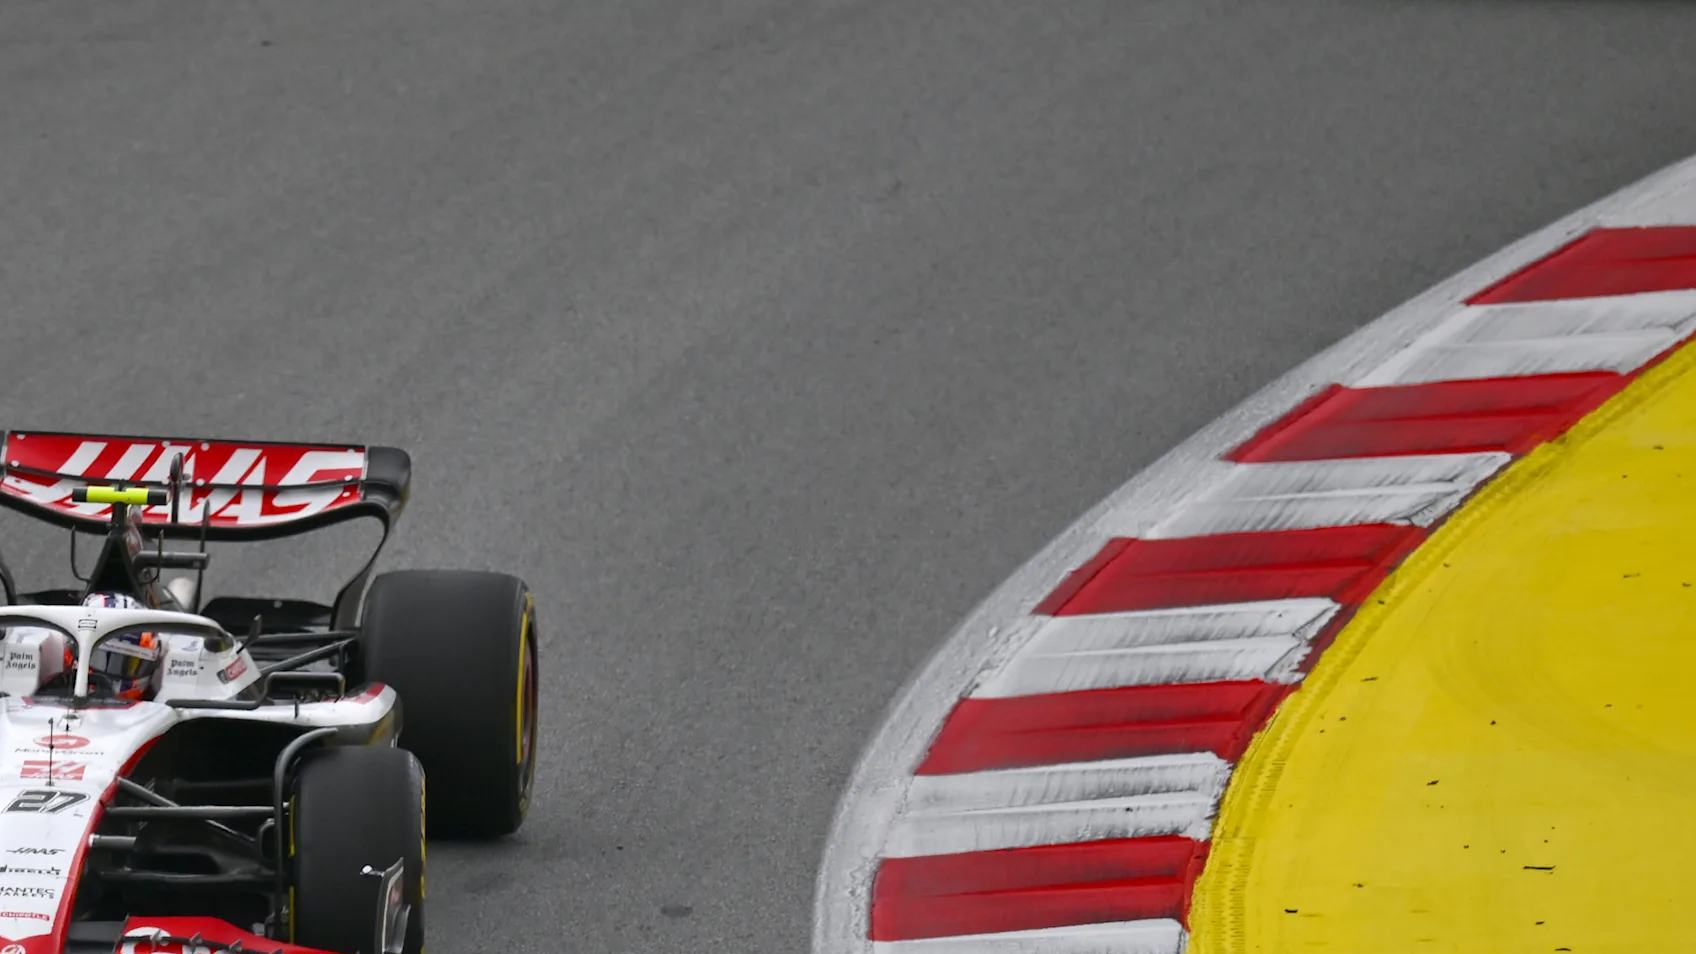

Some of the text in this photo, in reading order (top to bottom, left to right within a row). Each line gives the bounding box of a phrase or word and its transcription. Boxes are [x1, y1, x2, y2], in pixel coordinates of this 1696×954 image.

[10, 651, 34, 661] Palm
[5, 661, 36, 671] Angels
[0, 789, 91, 815] 27
